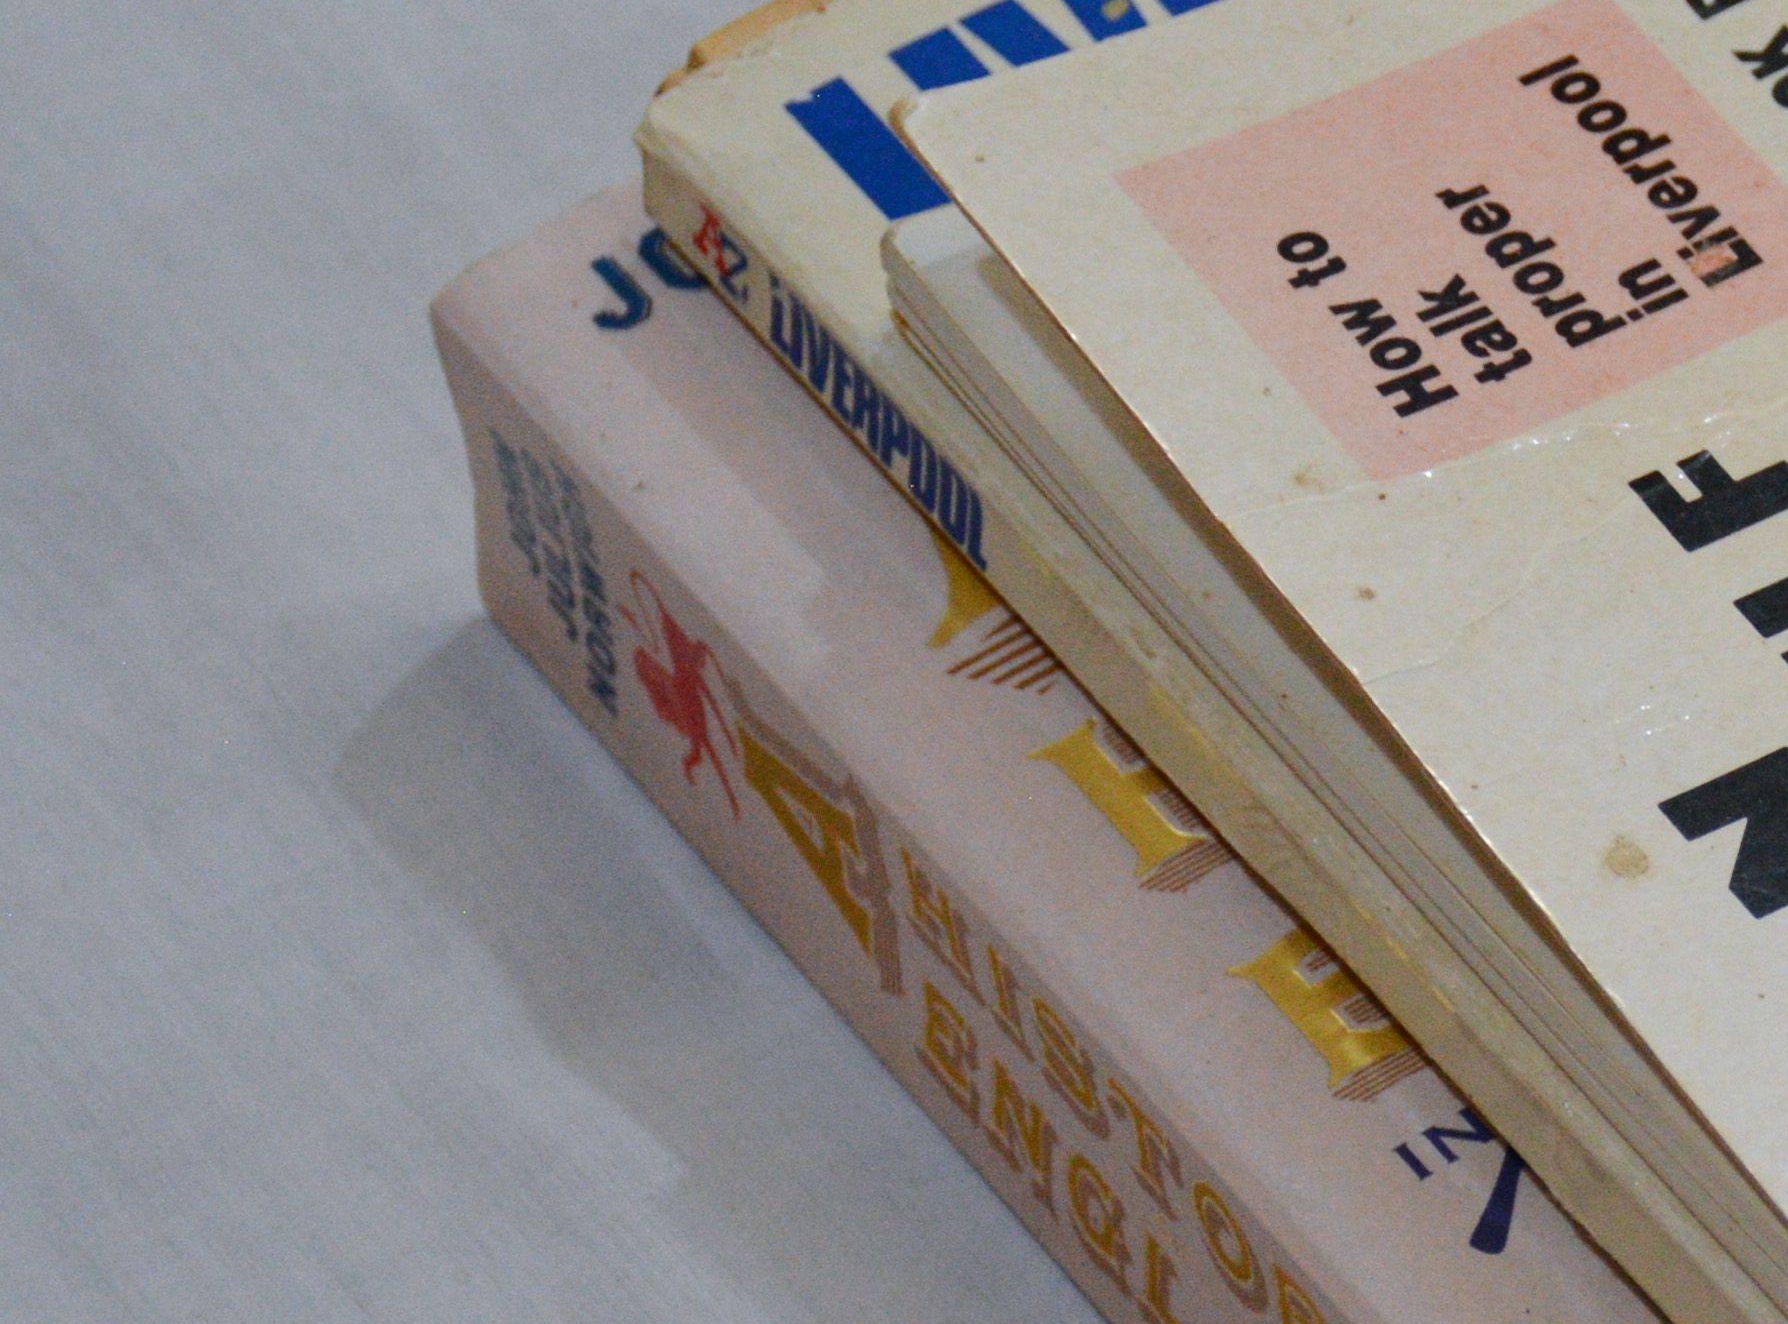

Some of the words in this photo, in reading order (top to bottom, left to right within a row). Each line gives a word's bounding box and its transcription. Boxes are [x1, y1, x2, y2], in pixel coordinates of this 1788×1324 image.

[1517, 54, 1764, 288] Liverpool
[1276, 230, 1348, 289] to
[1435, 183, 1628, 349] proper
[1618, 257, 1690, 321] in
[1330, 296, 1460, 419] How
[1417, 274, 1534, 385] talk
[767, 268, 988, 572] LIVERPOOL
